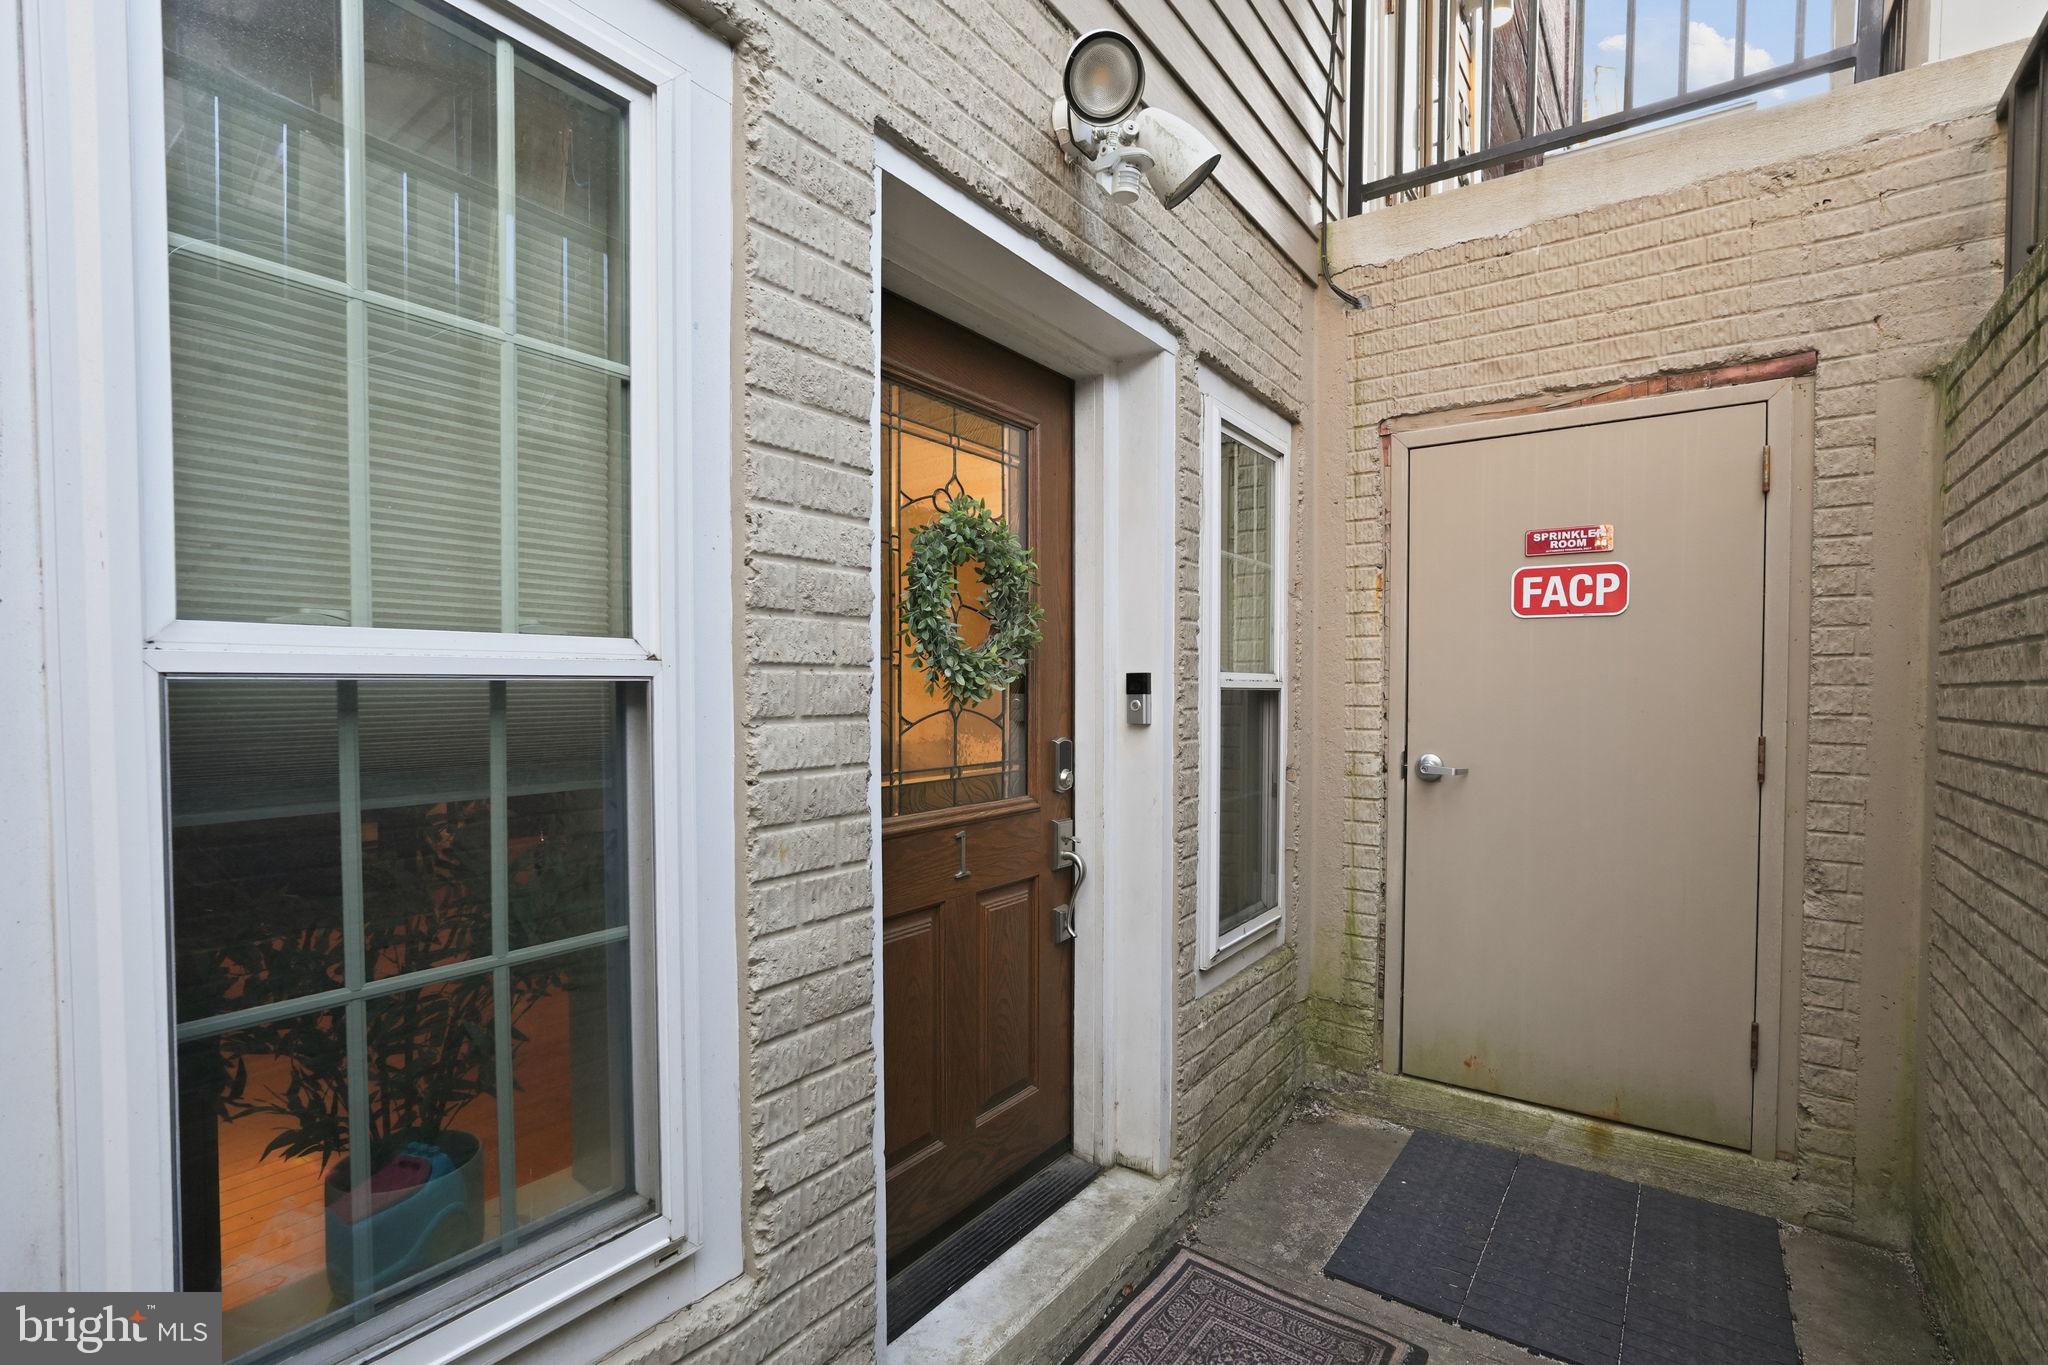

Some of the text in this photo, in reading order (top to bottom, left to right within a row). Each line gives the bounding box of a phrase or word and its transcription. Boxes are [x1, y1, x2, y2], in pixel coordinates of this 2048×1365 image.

[1550, 539, 1587, 549] ROOM
[1522, 573, 1620, 609] FACP
[953, 830, 971, 879] 1
